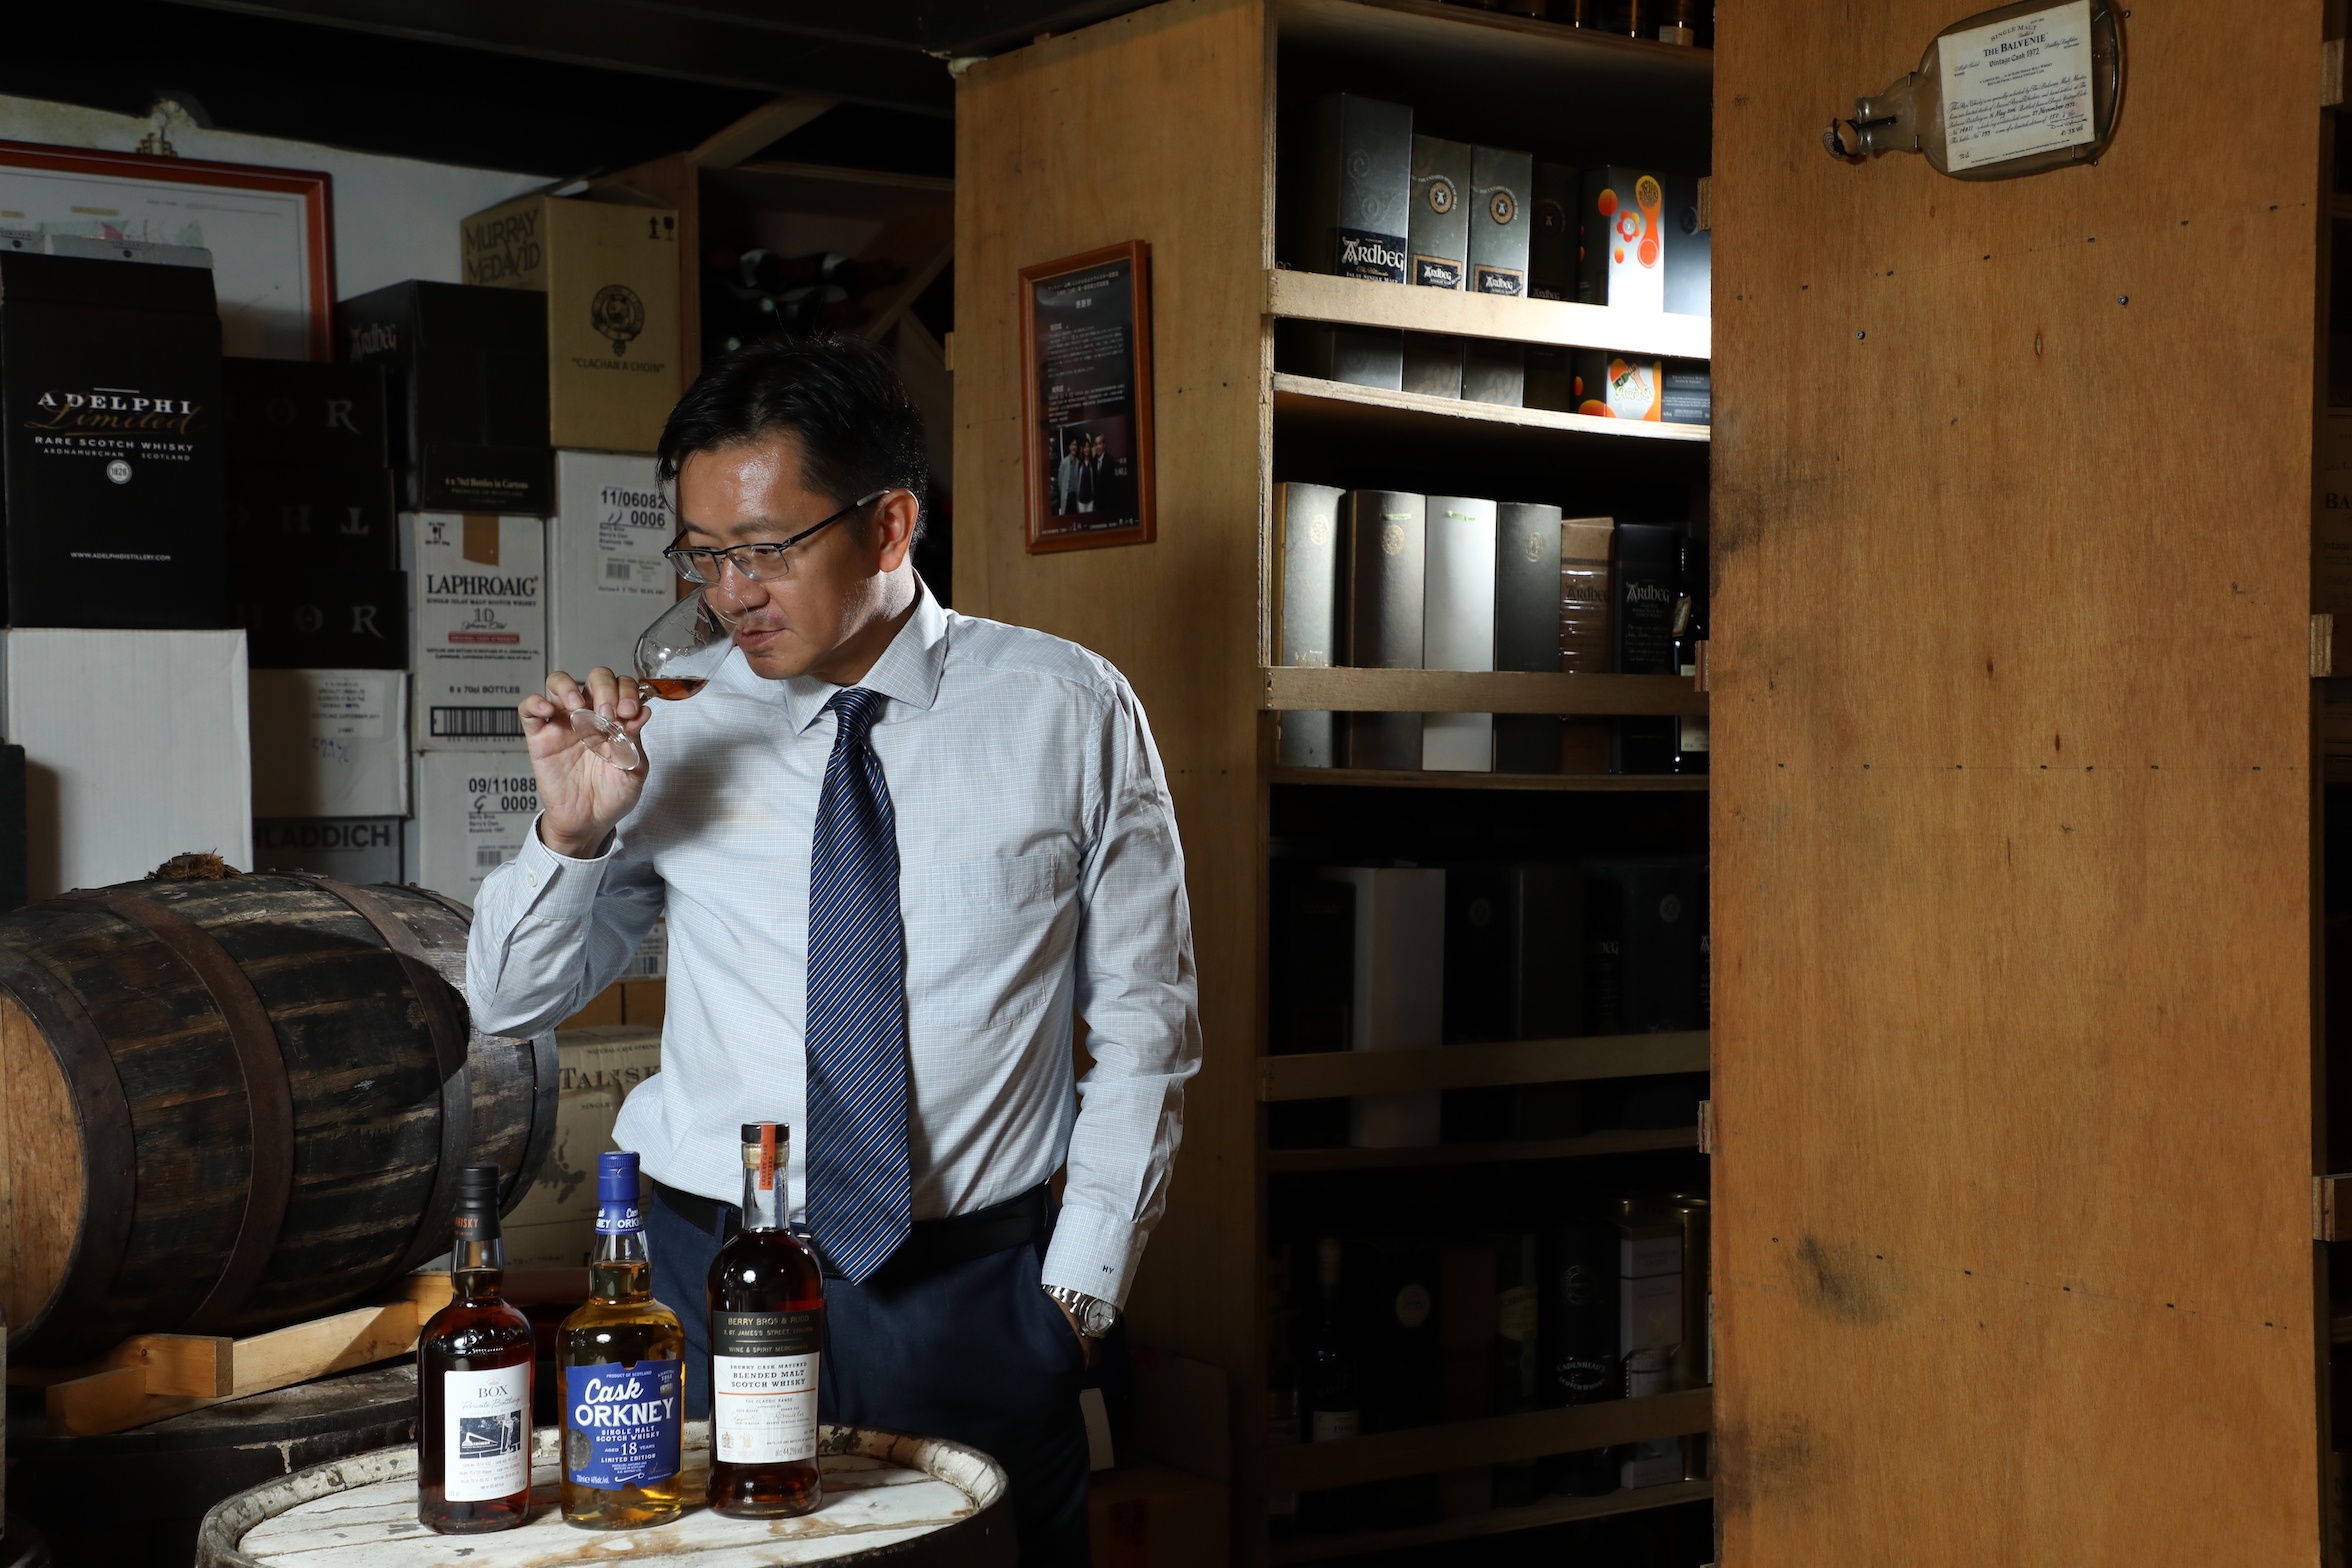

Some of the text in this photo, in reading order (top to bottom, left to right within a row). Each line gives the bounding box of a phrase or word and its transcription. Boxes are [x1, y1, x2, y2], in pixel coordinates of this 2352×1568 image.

[1991, 27, 2016, 42] SINGLE
[1984, 34, 2046, 57] THE BALVENIE
[1989, 48, 2040, 68] Vintage Cask 1972
[465, 208, 539, 254] MURRAY
[1341, 236, 1404, 271] Ardbeg
[1424, 265, 1452, 280] Ardbeg
[1485, 275, 1513, 290] Ardbeg
[622, 361, 629, 370] A
[37, 392, 192, 414] ADELPHI
[24, 391, 203, 435] Limited
[35, 436, 193, 452] RARE SCOTCH WHISKY
[44, 448, 190, 462] ARDNAMURCHAN SCOTLAND
[601, 490, 665, 509] 11/06082
[631, 510, 665, 527] 0006
[1625, 581, 1670, 603] Ardbeg
[474, 608, 494, 622] 10
[464, 686, 480, 694] 70cl
[482, 686, 520, 694] BOTTLES
[469, 778, 537, 793] 09/11088
[501, 796, 537, 810] 0009
[1102, 1265, 1114, 1274] HY
[791, 1315, 809, 1323] RUDD
[775, 1344, 808, 1352] MERCHANTS
[1556, 1361, 1606, 1372] CADENHEAD'S
[772, 1379, 806, 1387] WHISKY
[1558, 1377, 1606, 1391] SCOTCH WHISKY
[479, 1384, 508, 1398] BOX
[585, 1378, 644, 1404] Cask
[462, 1397, 521, 1410] Private Bottling
[575, 1397, 674, 1427] ORKNEY
[630, 1431, 660, 1441] WHISKY
[634, 1425, 655, 1434] MALT
[621, 1442, 637, 1456] 18
[630, 1453, 656, 1461] EDITION
